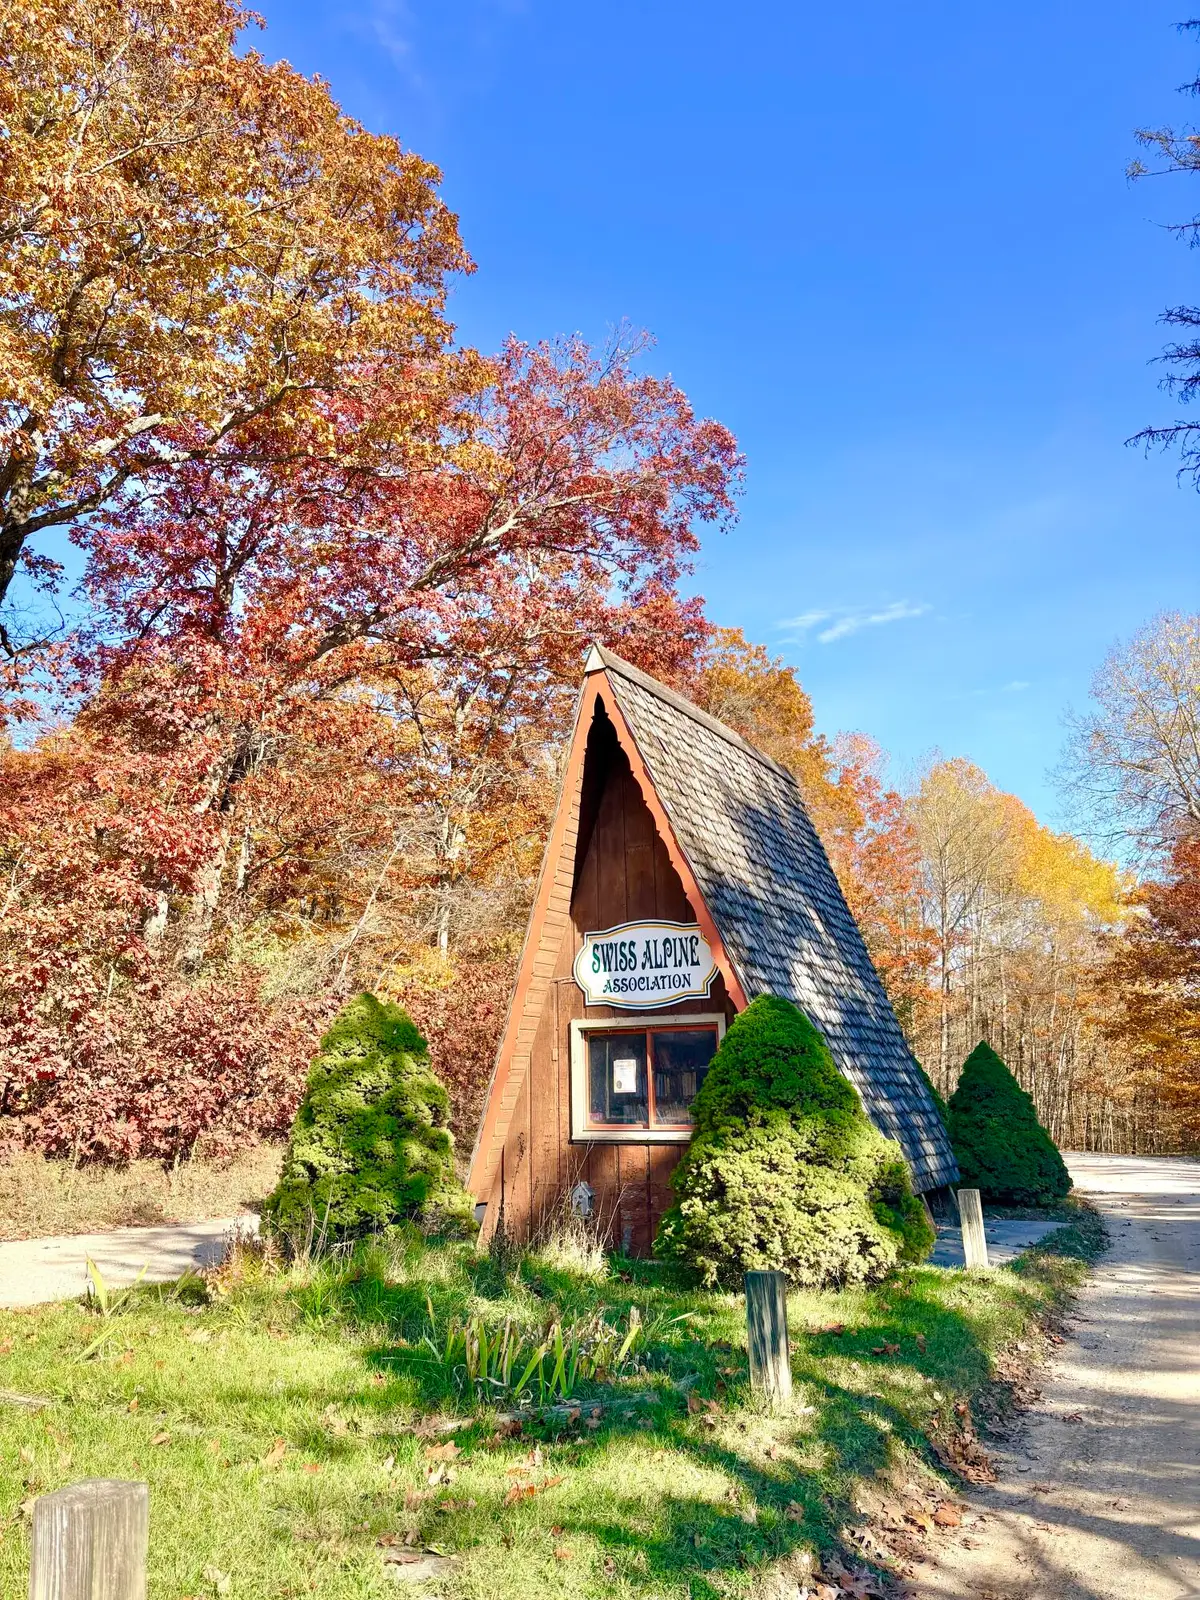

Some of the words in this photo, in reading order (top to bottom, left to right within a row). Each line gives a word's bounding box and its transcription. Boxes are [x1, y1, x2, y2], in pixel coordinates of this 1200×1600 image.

[592, 940, 637, 973] SWISS
[641, 935, 700, 970] ALPINE
[603, 973, 691, 993] ASSOCIATION
